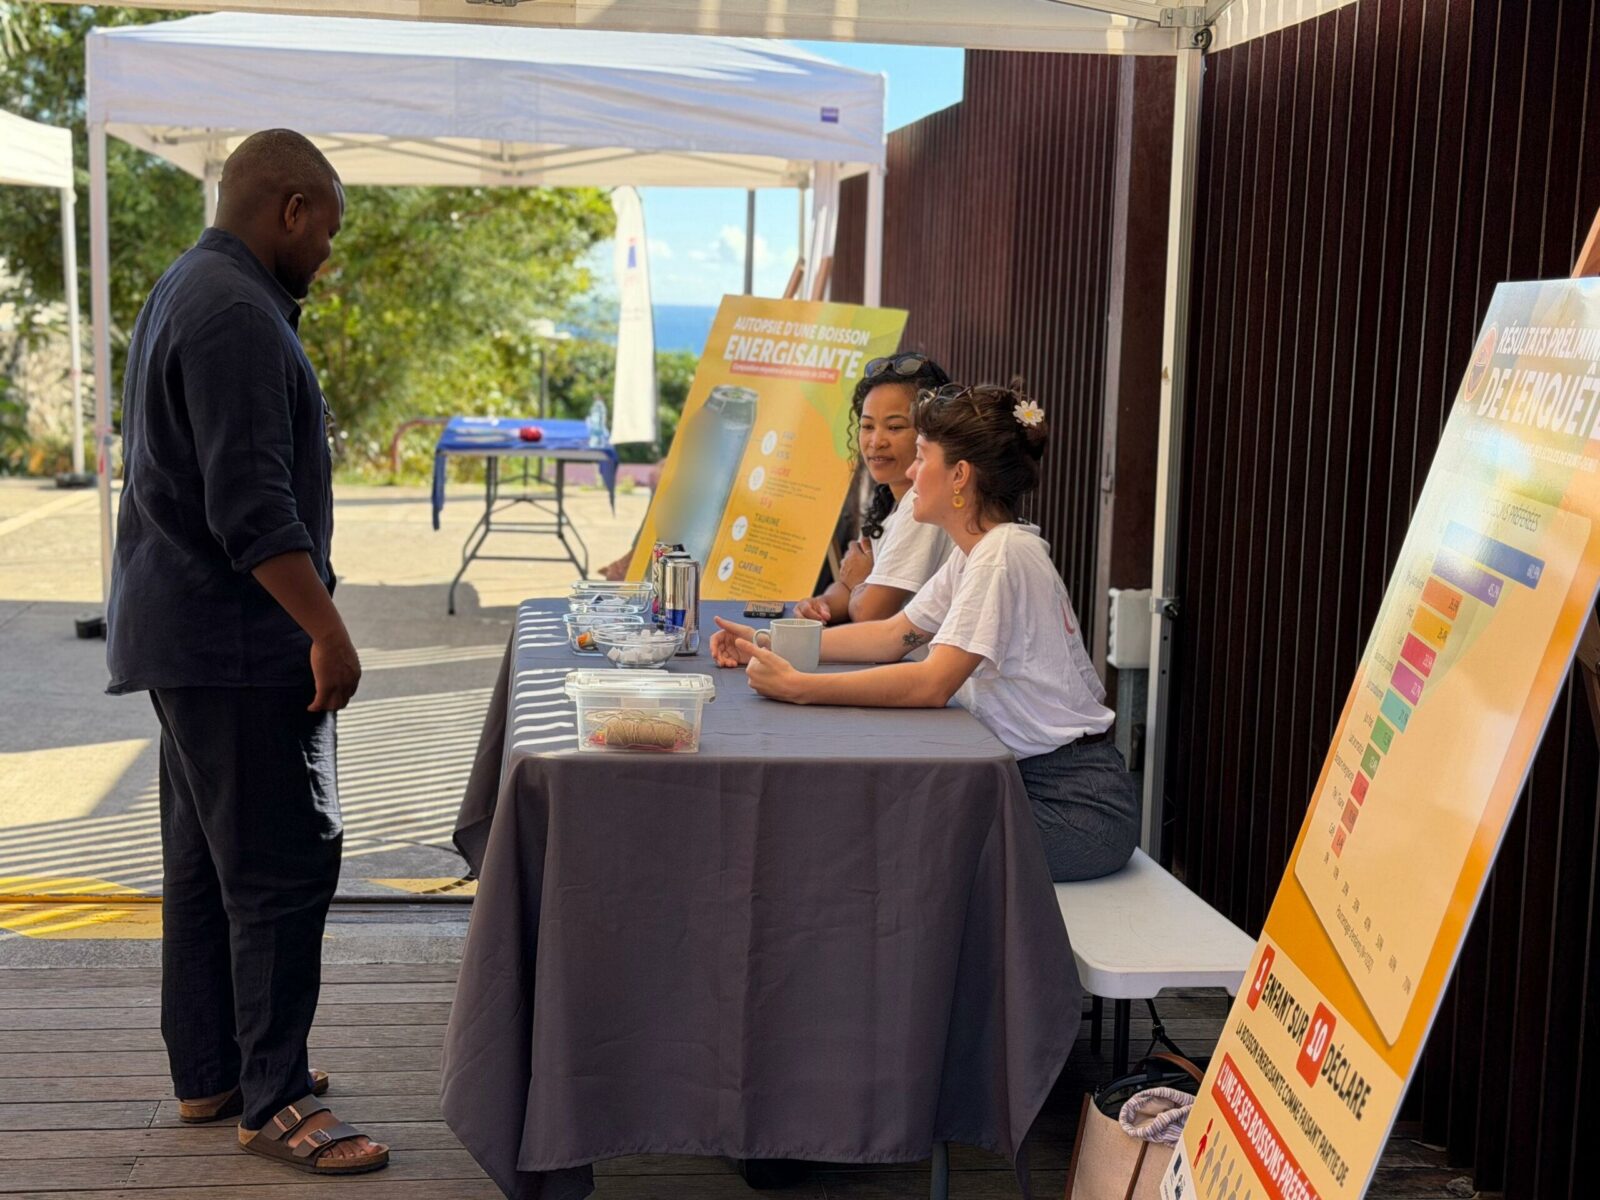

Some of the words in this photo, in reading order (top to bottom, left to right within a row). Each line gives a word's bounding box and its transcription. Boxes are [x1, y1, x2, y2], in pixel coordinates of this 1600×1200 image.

[733, 316, 784, 335] AUTOPSIE
[784, 321, 816, 339] D'UNE
[818, 324, 870, 346] BOISSON
[1496, 321, 1550, 355] RÉSULTATS
[724, 335, 863, 378] ENERGISANTE
[1477, 368, 1512, 416] DE
[1507, 504, 1542, 531] PRÉFÉRÉES
[1255, 957, 1268, 990] 1
[1262, 973, 1294, 1025] ENFANT
[1287, 1004, 1309, 1045] SUR
[1306, 1016, 1329, 1062] 10
[1321, 1044, 1371, 1121] DÉCLARE
[1218, 1061, 1237, 1102] L'UNE
[1231, 1084, 1244, 1113] DE
[1238, 1097, 1254, 1131] SES
[1247, 1112, 1284, 1181] BOISSONS
[1236, 1020, 1243, 1037] LA
[1241, 1027, 1259, 1059] BOISSON
[1256, 1047, 1284, 1096] ENERGISANTE
[1281, 1083, 1301, 1120] COMME
[1298, 1108, 1321, 1148] FAISANT
[1317, 1136, 1339, 1174] PARTIE
[1336, 1161, 1348, 1187] DE
